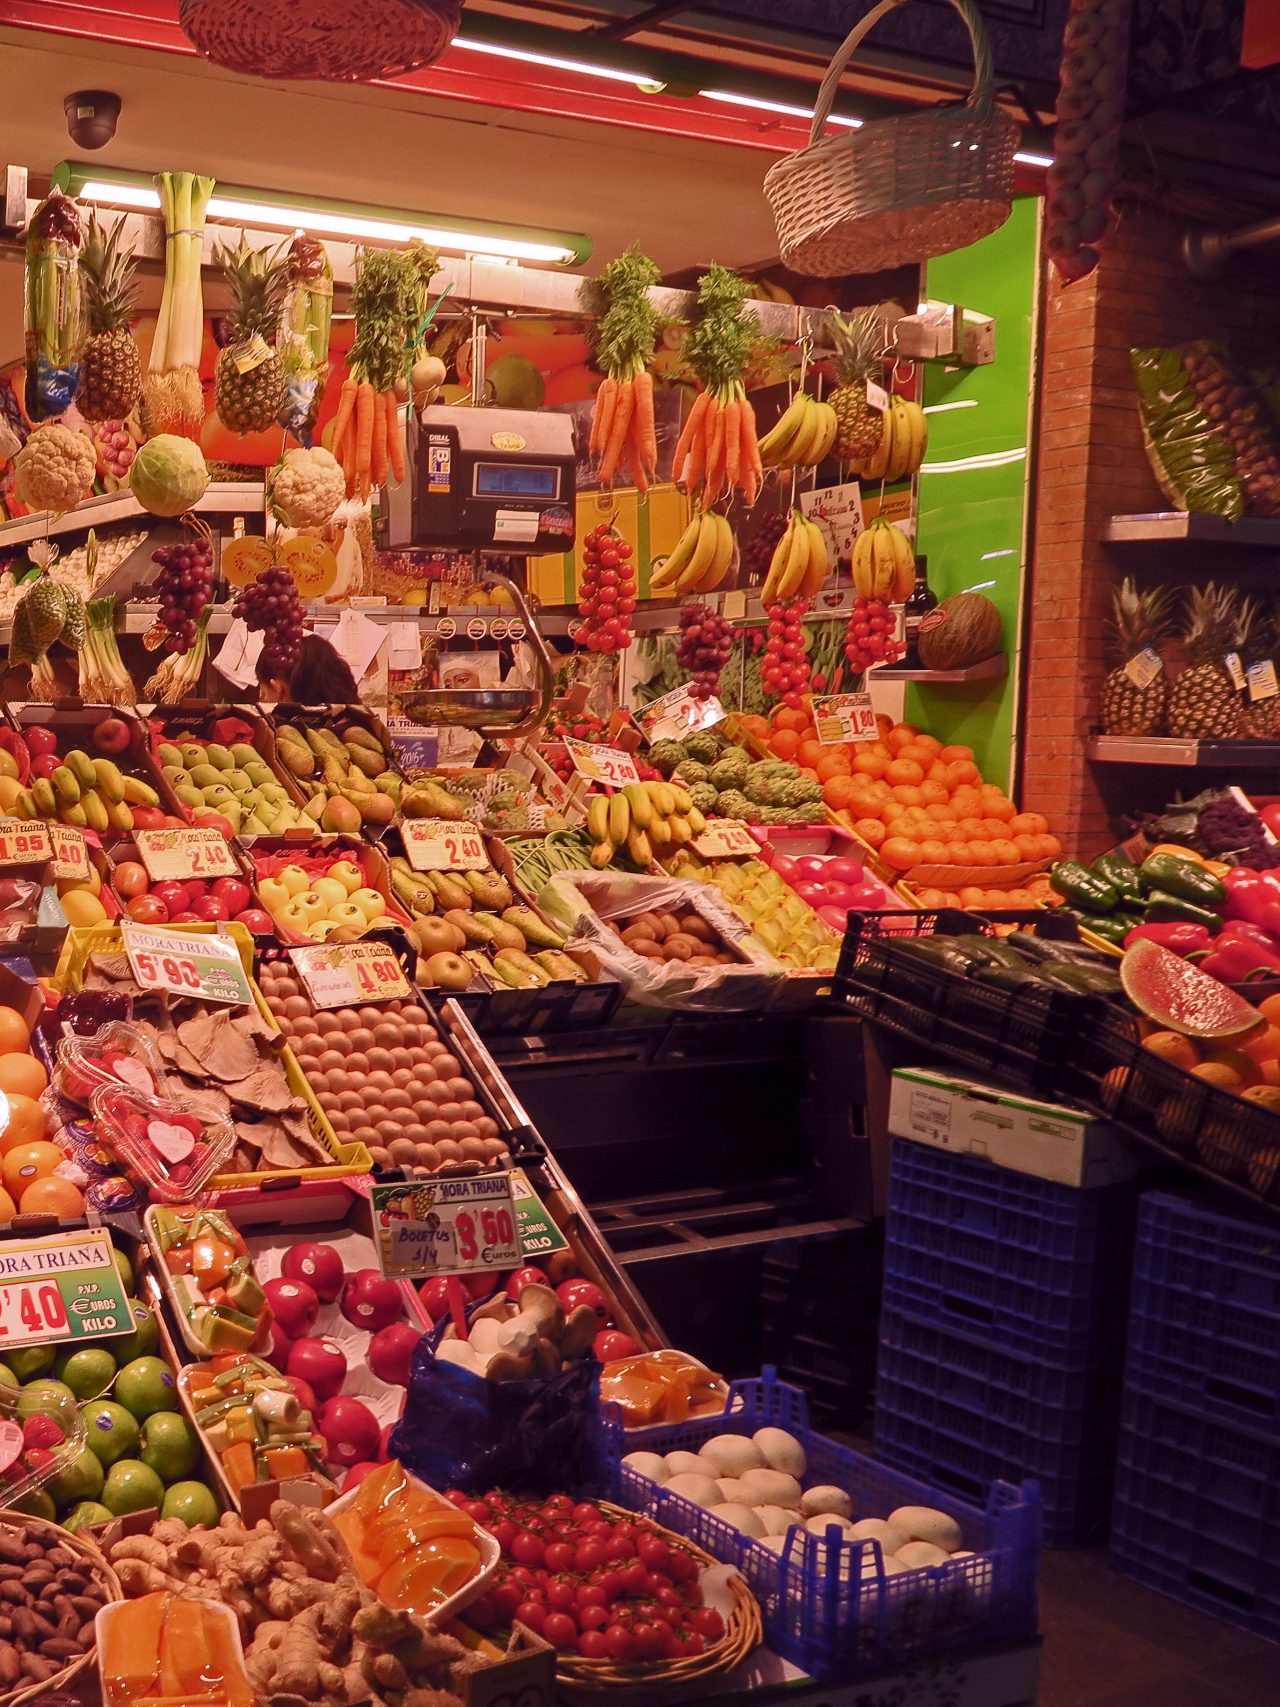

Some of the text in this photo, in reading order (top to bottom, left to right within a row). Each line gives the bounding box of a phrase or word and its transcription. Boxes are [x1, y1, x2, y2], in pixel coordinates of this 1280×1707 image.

[131, 933, 174, 951] MORA
[135, 953, 201, 989] 5'90
[213, 988, 240, 1000] KILO
[441, 1183, 470, 1197] MORA
[471, 1178, 507, 1194] TRIANA
[455, 1209, 513, 1261] 3'50
[524, 1236, 552, 1250] KILO
[33, 1246, 104, 1269] TRIANA
[81, 1315, 118, 1333] KILO
